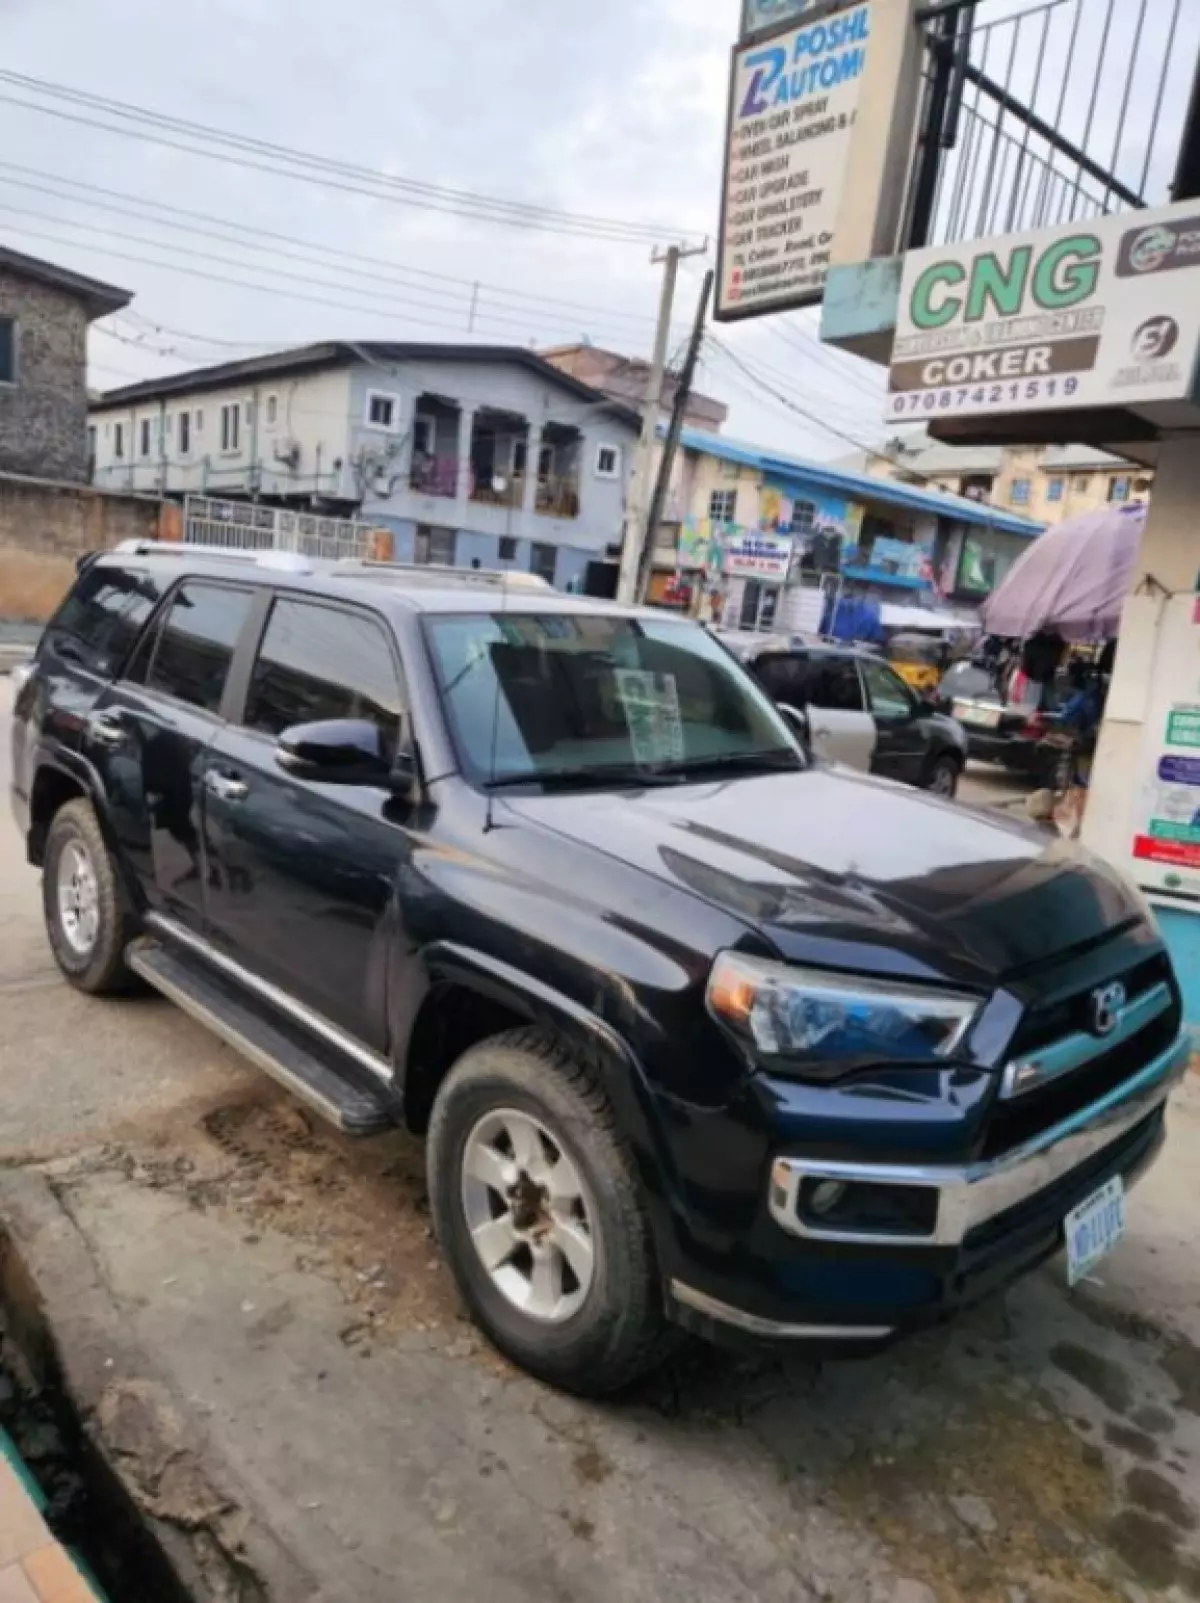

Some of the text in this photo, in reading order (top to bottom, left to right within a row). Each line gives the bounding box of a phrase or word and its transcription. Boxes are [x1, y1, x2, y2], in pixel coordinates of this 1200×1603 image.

[910, 233, 1103, 329] CNG
[921, 346, 1052, 385] COKER
[893, 375, 1079, 413] 07087421519
